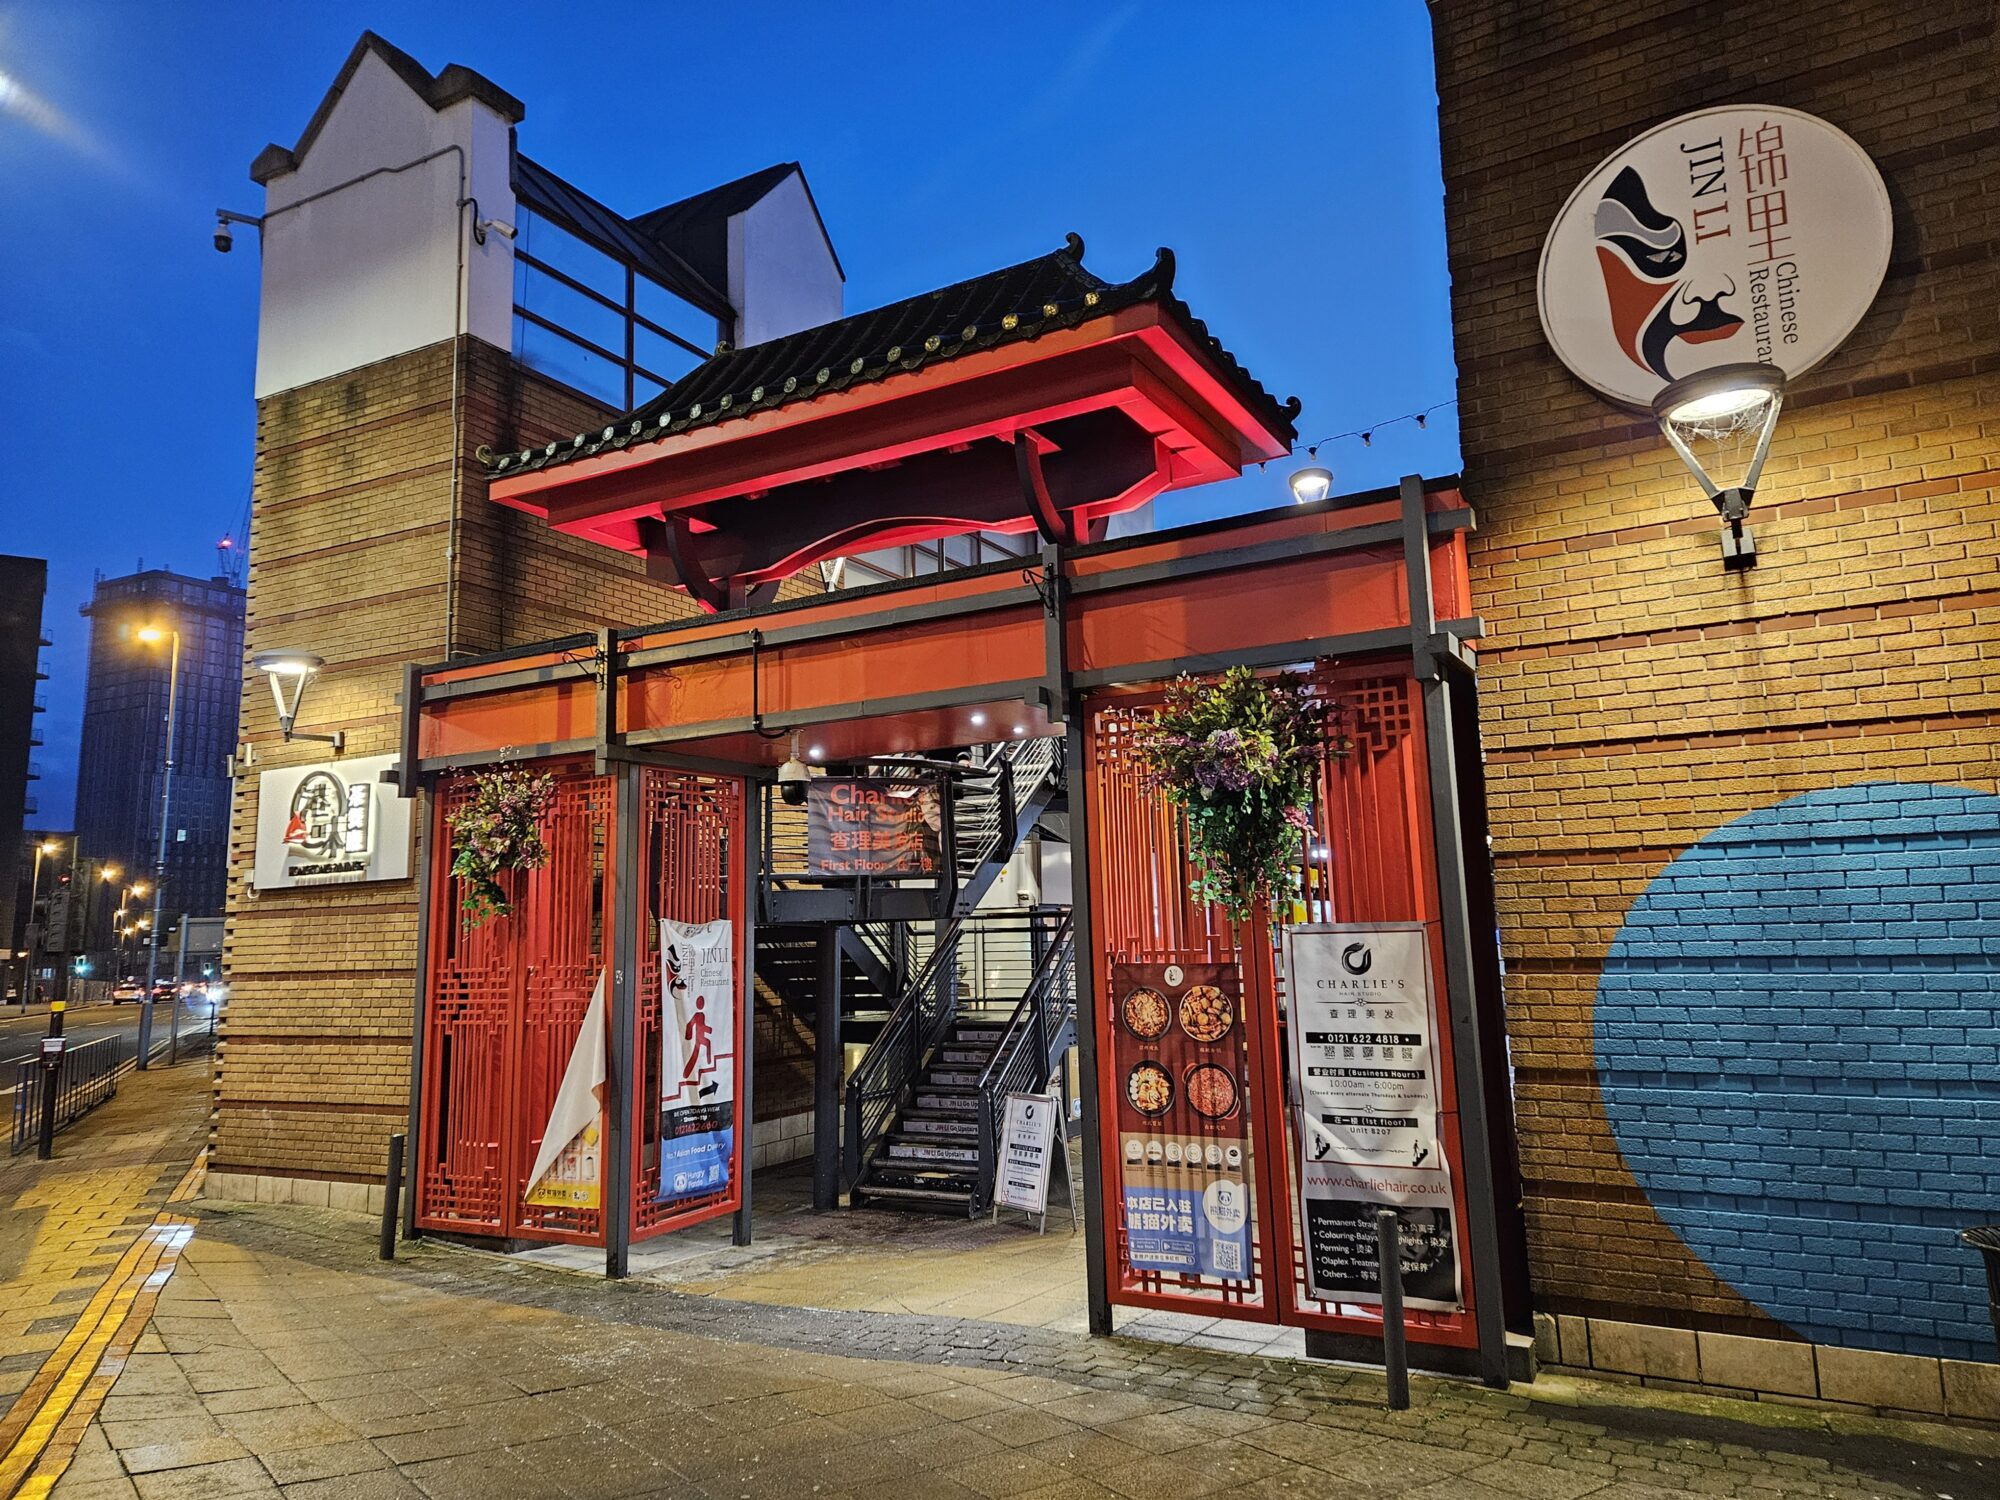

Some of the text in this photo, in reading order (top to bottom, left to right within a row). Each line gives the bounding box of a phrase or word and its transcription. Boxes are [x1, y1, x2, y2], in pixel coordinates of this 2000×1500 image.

[1680, 136, 1731, 245] JIN LI
[1738, 121, 1795, 266] 锦里
[1776, 262, 1800, 345] Chinese
[1749, 266, 1773, 364] Restauran
[827, 805, 925, 824] Hair Studio
[820, 859, 850, 871] First
[1316, 979, 1405, 990] CHARLIE'S
[1329, 1009, 1394, 1020] 查理美发
[1327, 1034, 1400, 1045] 0121 622 4818
[1348, 1068, 1389, 1078] (Business
[1391, 1070, 1420, 1079] Hours)
[1329, 1079, 1365, 1089] 10:00am
[1374, 1080, 1405, 1091] 6:00pm
[1361, 1117, 1378, 1127] (1st
[1380, 1118, 1407, 1128] floor)
[1350, 1127, 1368, 1135] Unit
[690, 1145, 706, 1154] Food
[687, 1169, 706, 1179] Hungry
[1307, 1175, 1447, 1195] www.charliehair.co.uk
[1127, 1196, 1192, 1214] 本店已入驻
[1128, 1212, 1193, 1234] 熊猫外卖
[1317, 1217, 1357, 1228] Permanent
[1319, 1243, 1350, 1255] Perming
[1321, 1256, 1349, 1266] Olaplex
[1349, 1257, 1380, 1268] Treatme
[1322, 1269, 1354, 1279] Others...
